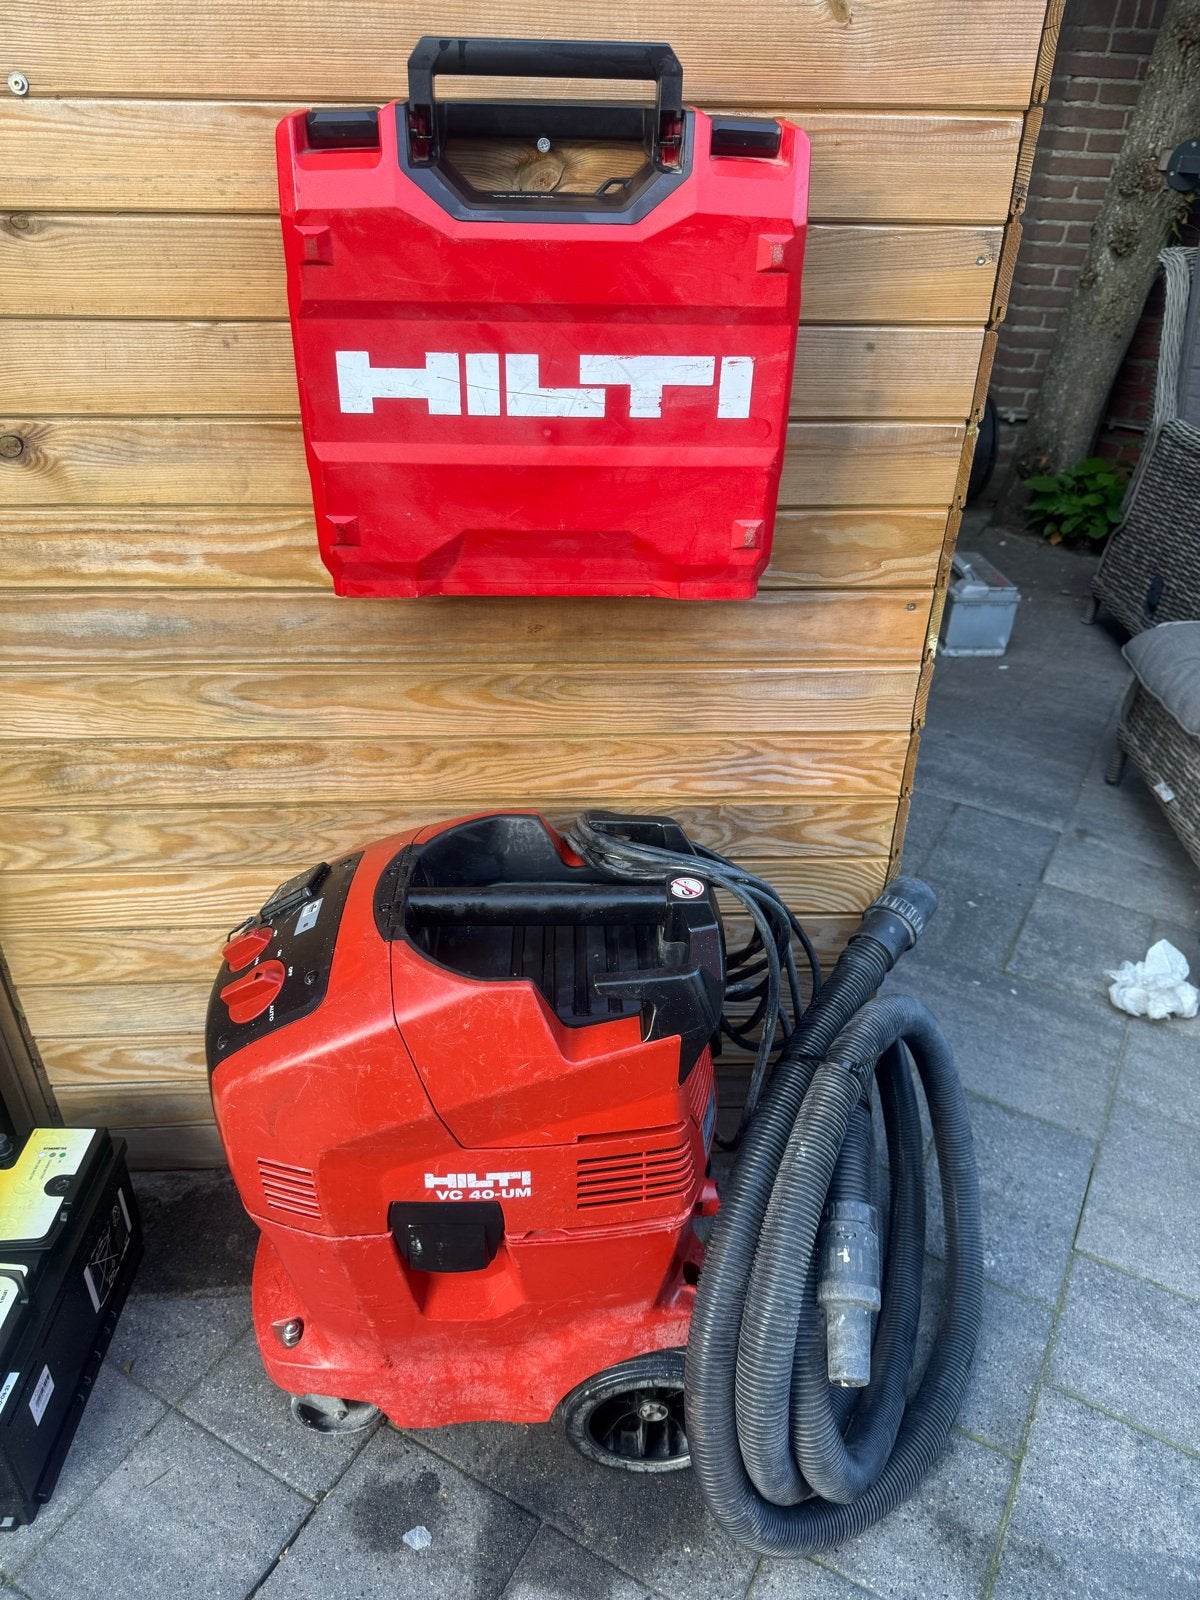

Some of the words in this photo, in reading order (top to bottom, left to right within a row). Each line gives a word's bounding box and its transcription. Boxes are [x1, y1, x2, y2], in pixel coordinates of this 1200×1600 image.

[335, 350, 756, 419] HILTI
[424, 1171, 531, 1188] HILTI
[435, 1190, 463, 1200] VC
[469, 1188, 532, 1199] 40-UM
